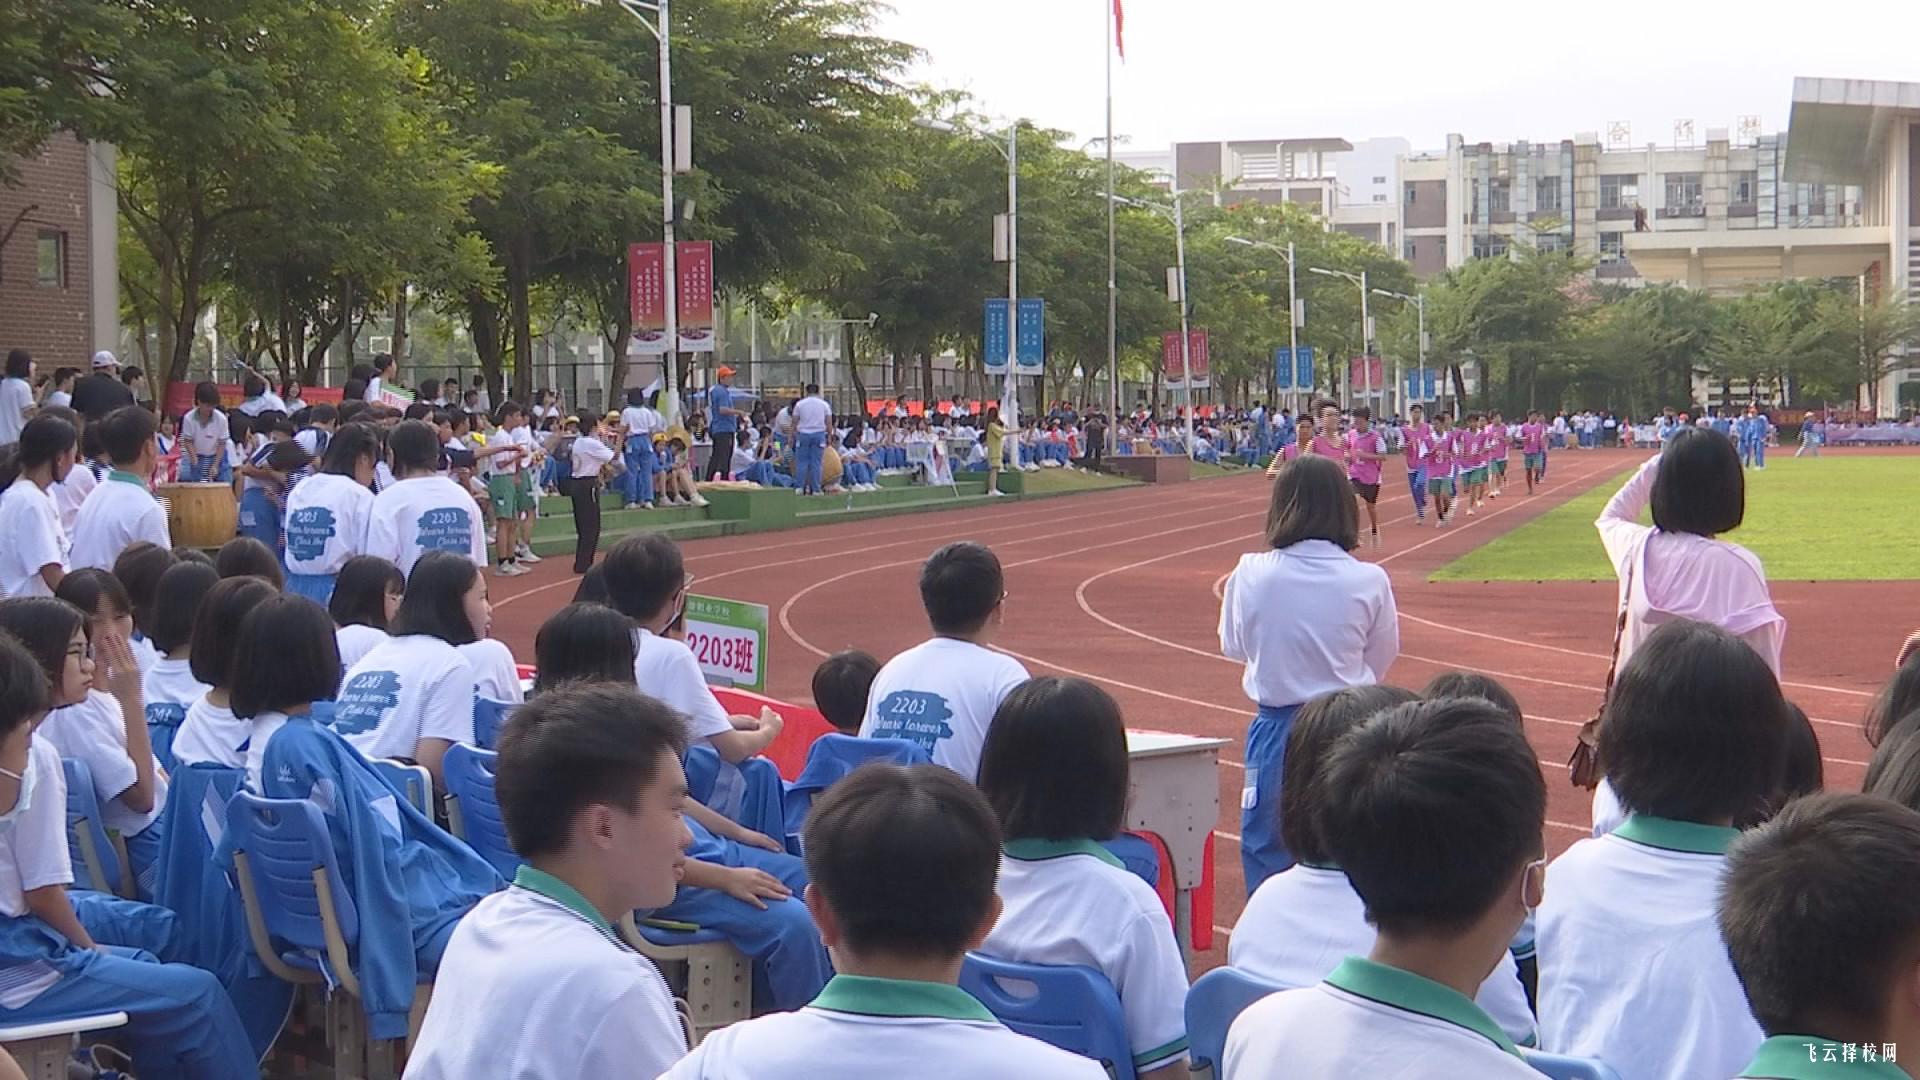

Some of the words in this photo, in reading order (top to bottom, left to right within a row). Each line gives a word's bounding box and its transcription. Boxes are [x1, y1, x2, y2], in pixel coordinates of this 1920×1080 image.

[431, 511, 458, 525] 2203
[687, 632, 754, 674] 2203班
[890, 696, 927, 715] 2203
